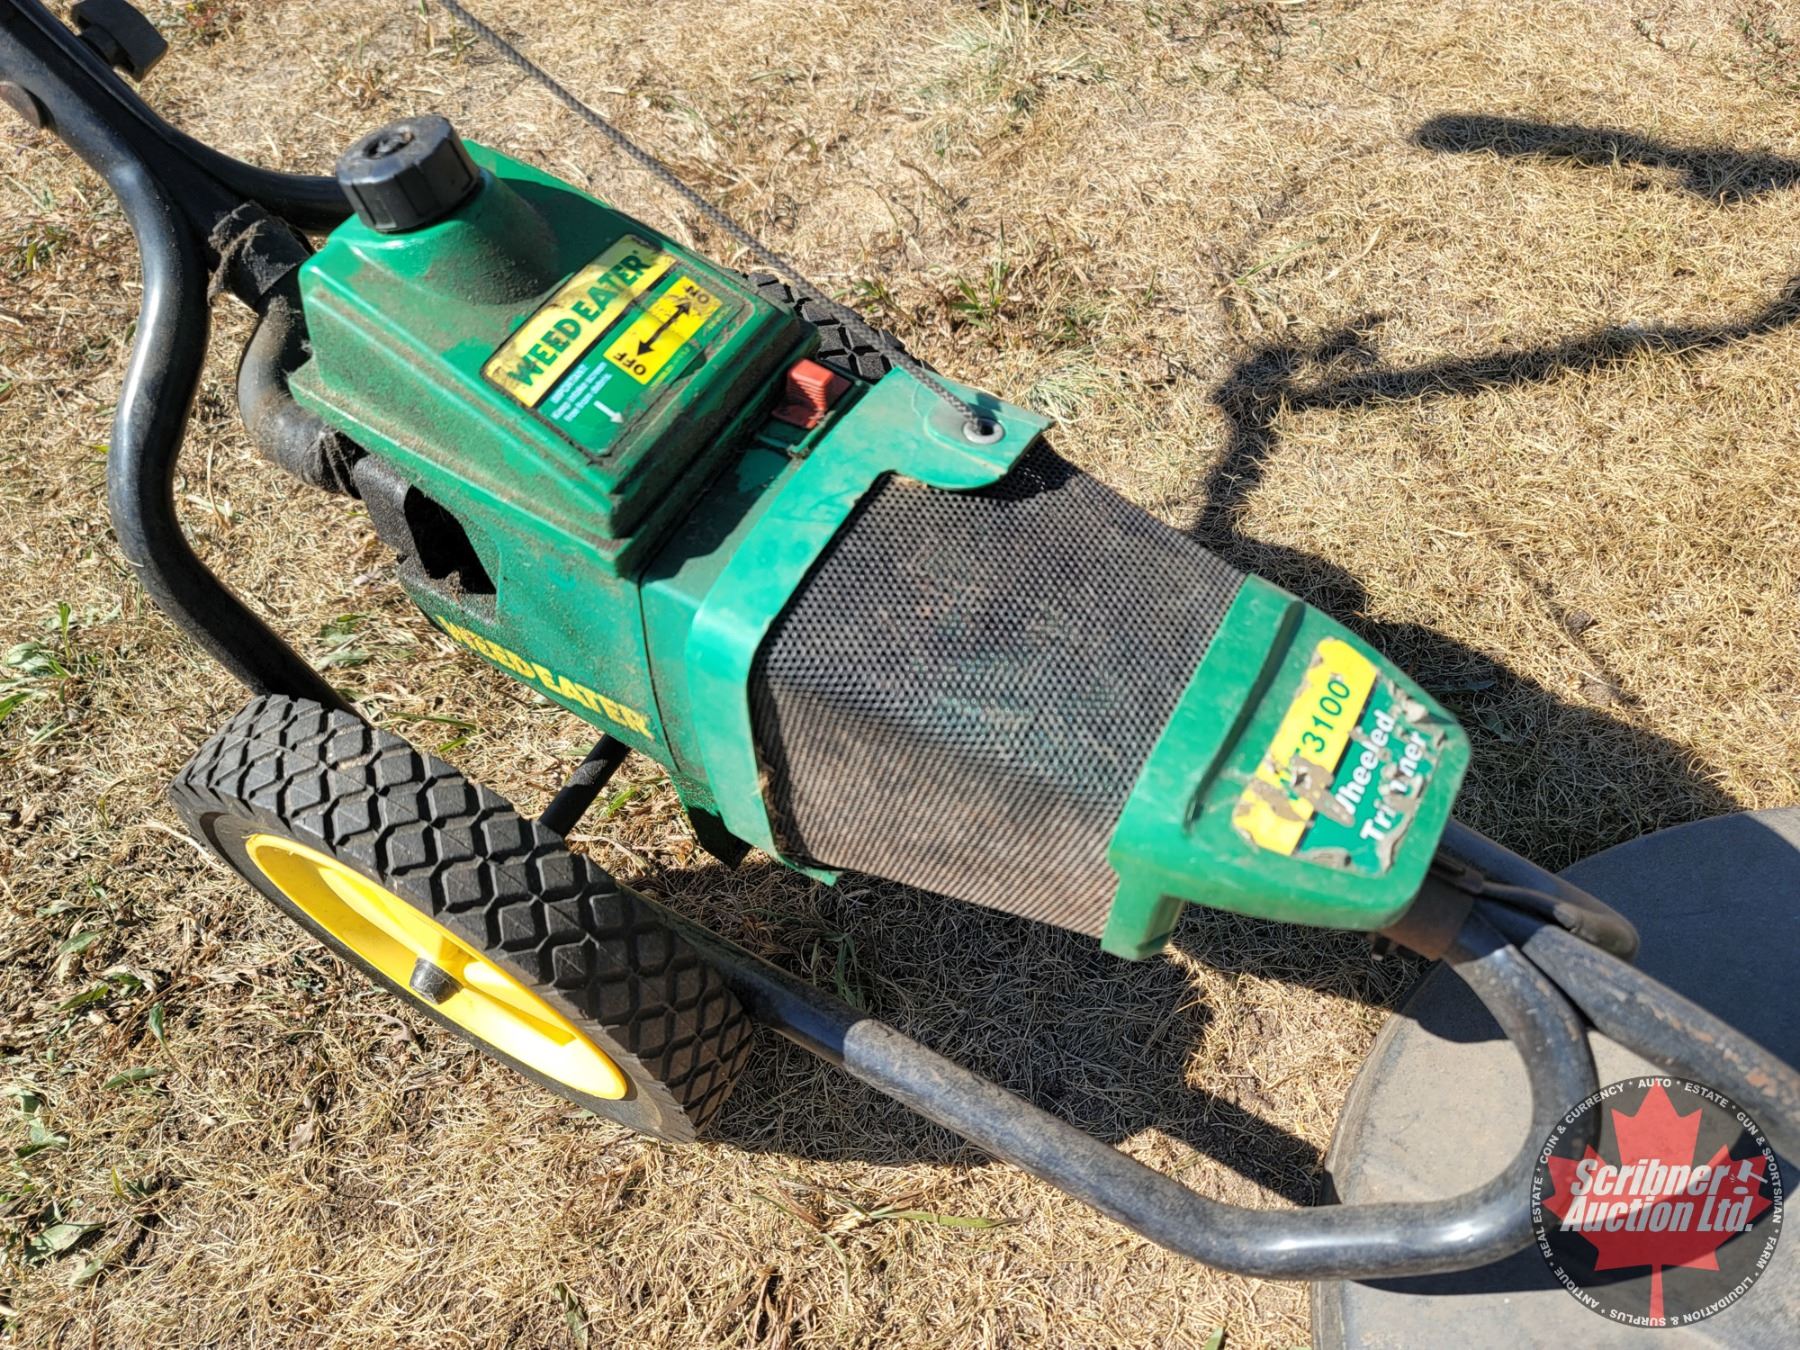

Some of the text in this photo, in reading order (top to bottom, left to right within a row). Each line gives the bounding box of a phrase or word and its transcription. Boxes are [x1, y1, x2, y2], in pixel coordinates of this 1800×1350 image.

[507, 319, 582, 387] WEED
[570, 255, 651, 323] EATER
[684, 285, 710, 304] ON
[613, 351, 647, 376] OFF
[1336, 709, 1397, 815] heeled
